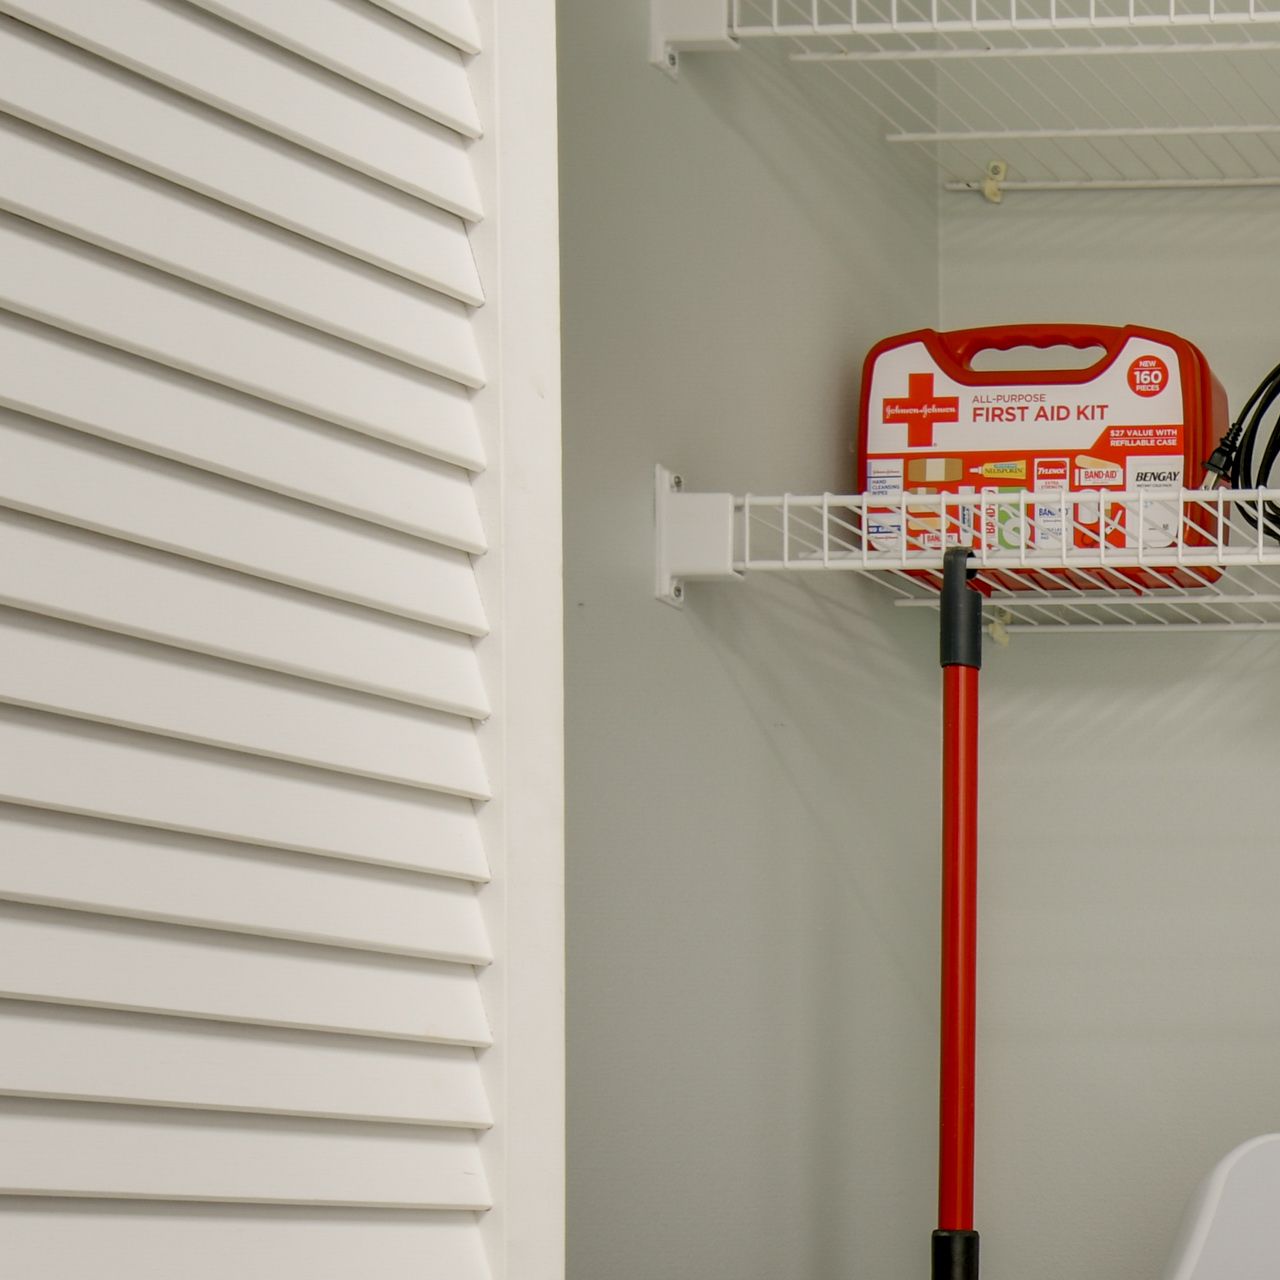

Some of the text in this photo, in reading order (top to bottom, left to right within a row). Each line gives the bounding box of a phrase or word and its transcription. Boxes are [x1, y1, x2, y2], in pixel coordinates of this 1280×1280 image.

[1134, 371, 1162, 384] 160
[1136, 384, 1160, 392] PIECES
[972, 393, 1047, 404] ALL-PURPOSE
[972, 405, 1109, 423] FIRST AID KIT
[1110, 428, 1178, 437] $27 VALUE WITH
[1110, 438, 1177, 447] REFILLABLE CASE
[1084, 470, 1117, 480] BAND-AID
[1135, 471, 1181, 482] BENGAY
